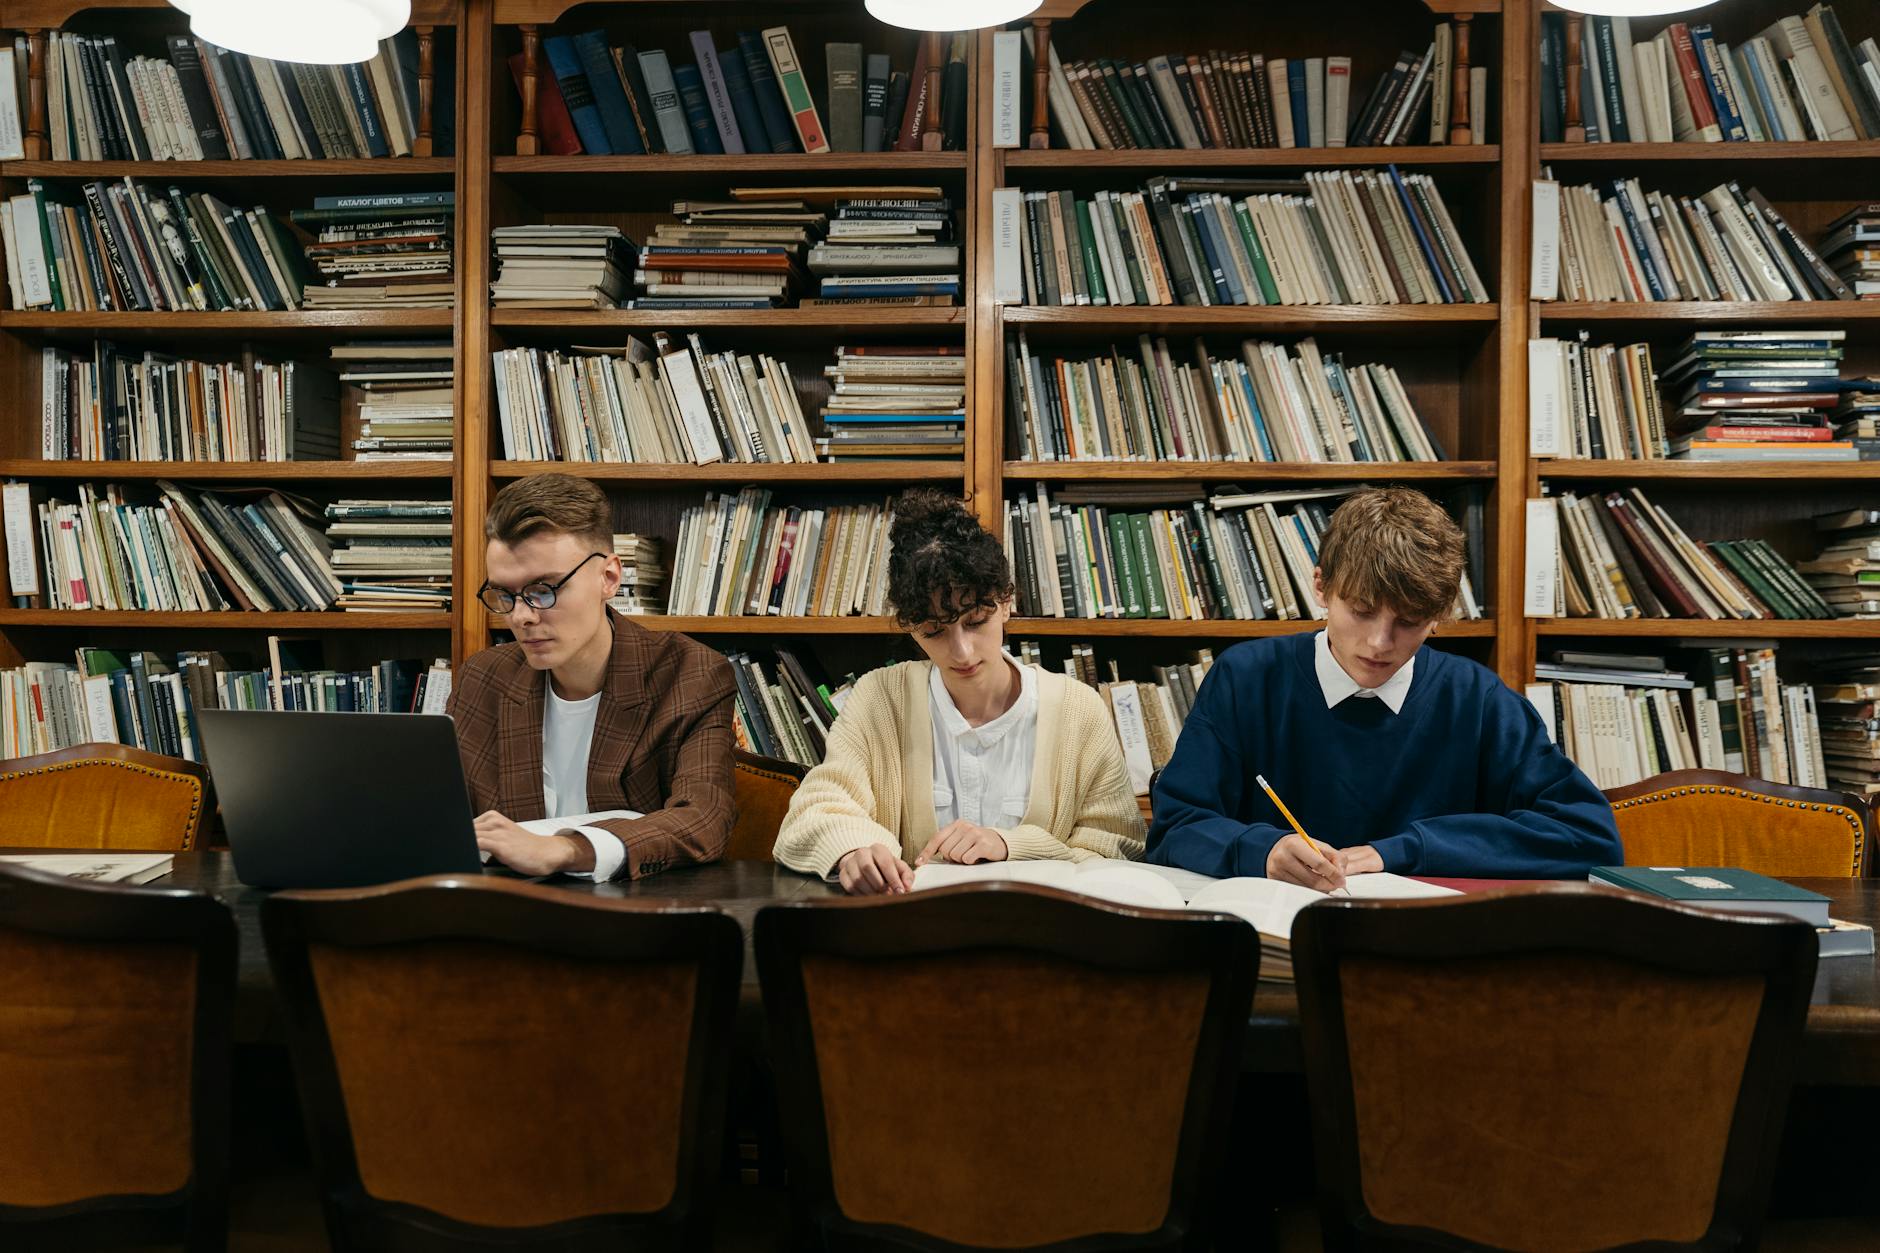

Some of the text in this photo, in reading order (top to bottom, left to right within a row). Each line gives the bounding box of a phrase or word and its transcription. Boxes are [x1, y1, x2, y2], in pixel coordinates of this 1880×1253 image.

[338, 197, 403, 207] КАТАЛОГ ЦВЕТОВ
[849, 199, 919, 208] ЦВЕТОВЕДЕНИЕ
